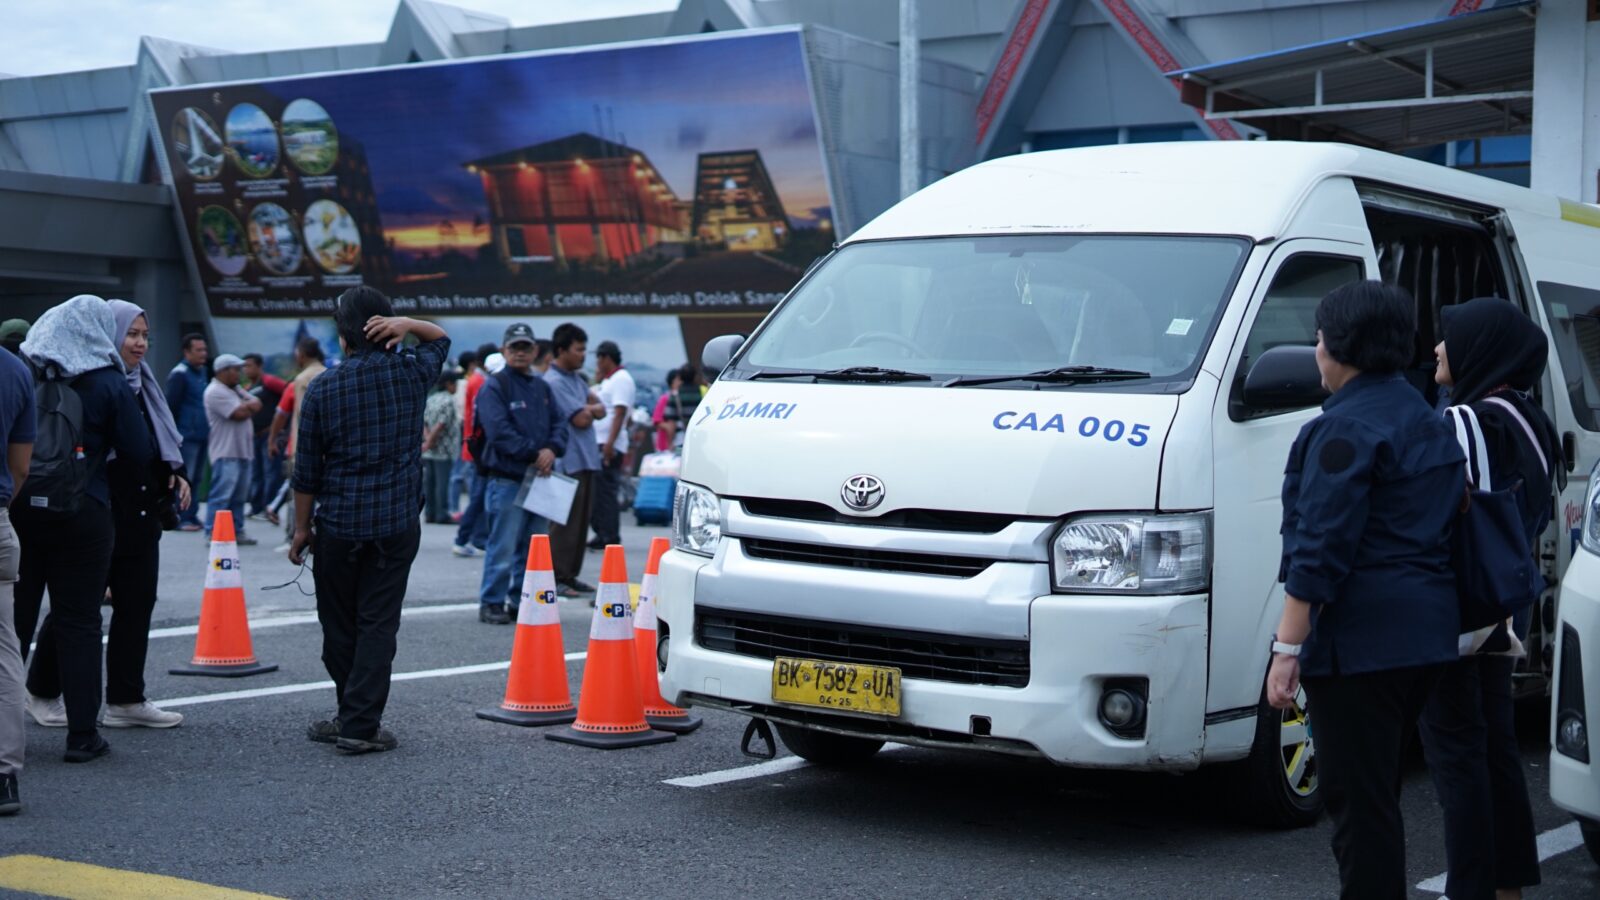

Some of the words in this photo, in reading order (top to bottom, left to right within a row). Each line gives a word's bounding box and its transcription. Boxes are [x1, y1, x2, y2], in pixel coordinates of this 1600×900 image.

[310, 297, 334, 310] and
[418, 294, 451, 308] Toba
[453, 294, 488, 308] from
[490, 293, 541, 308] CHADS
[553, 292, 602, 307] Coffee
[605, 291, 647, 305] Hotel
[650, 291, 692, 308] Ayola
[694, 290, 742, 305] Dolok
[717, 402, 797, 420] DAMRI
[993, 411, 1064, 433] CAA
[1078, 416, 1150, 447] 005
[778, 661, 801, 688] BK
[813, 662, 857, 694] 7582
[873, 670, 894, 698] UA
